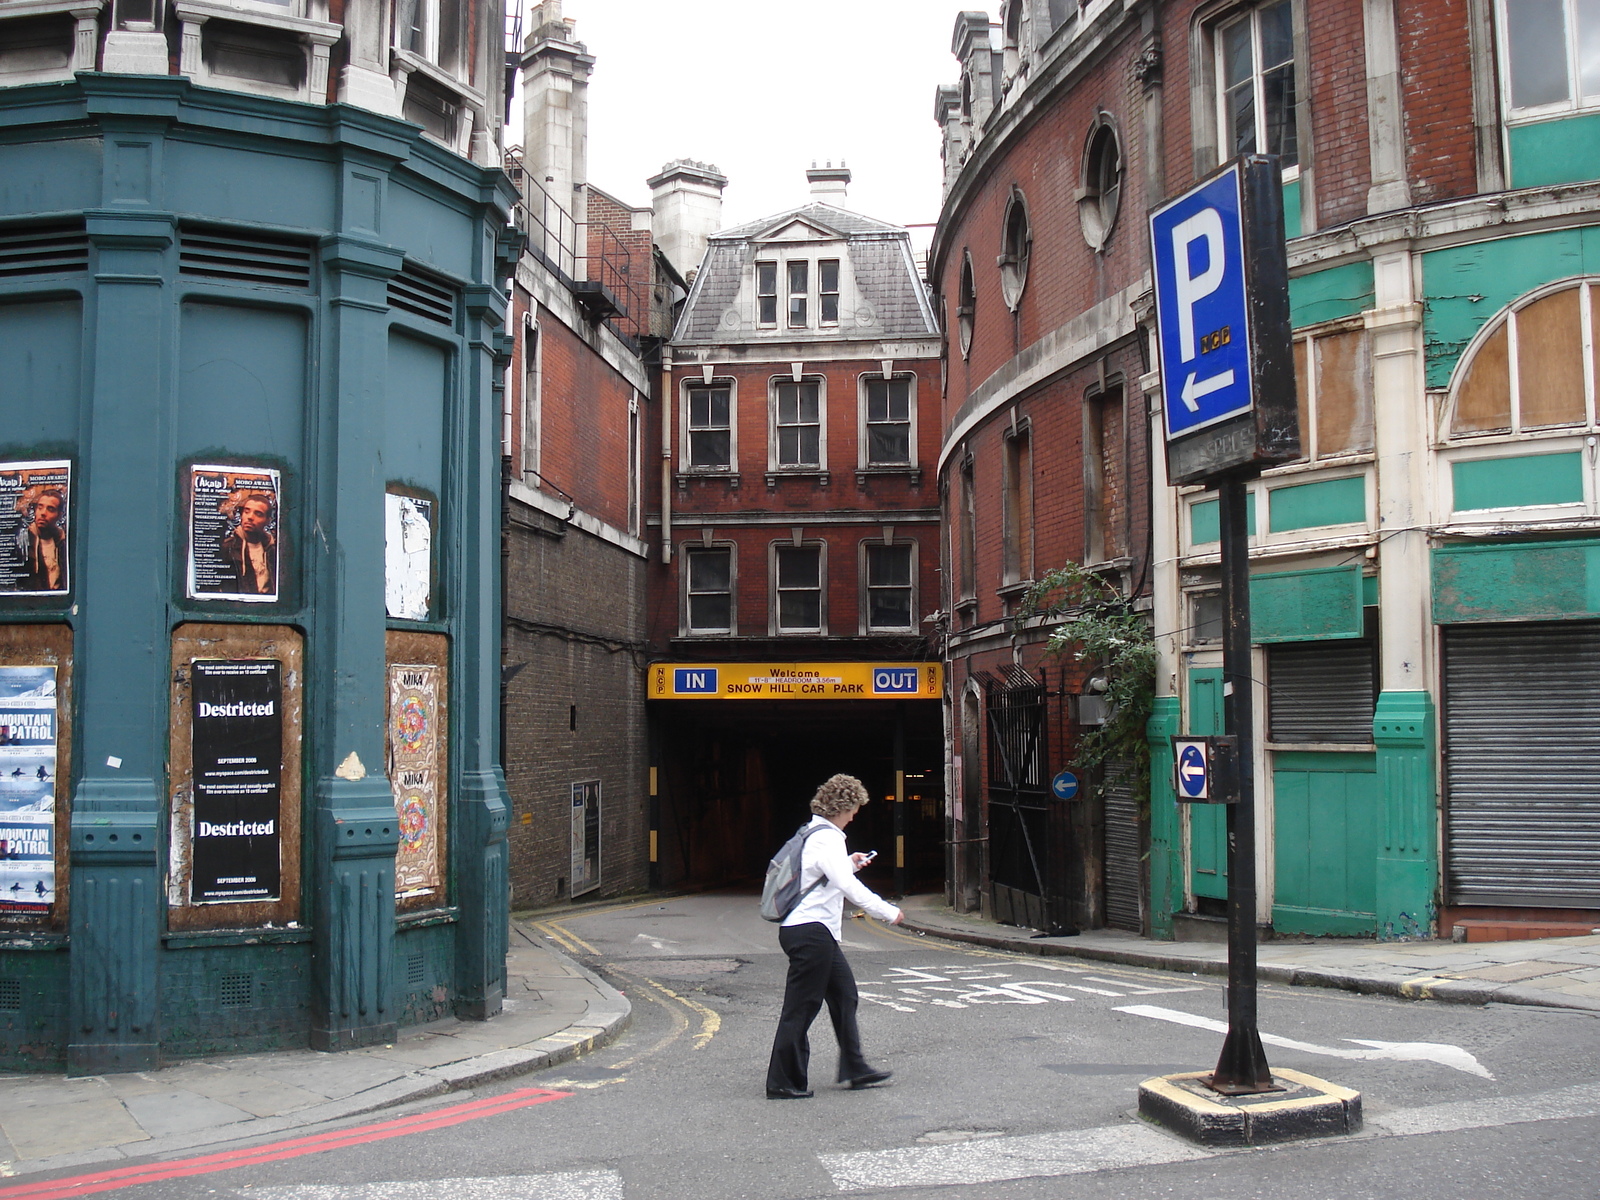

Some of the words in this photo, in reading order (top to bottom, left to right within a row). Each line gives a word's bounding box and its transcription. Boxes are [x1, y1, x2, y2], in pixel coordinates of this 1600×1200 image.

[1172, 207, 1225, 364] P
[1201, 326, 1231, 354] NCP
[404, 675, 422, 685] MIKA
[686, 673, 705, 688] IN
[876, 673, 915, 688] OUT
[728, 684, 762, 693] SNOW
[802, 685, 825, 693] CAR
[199, 701, 274, 717] Destricted
[0, 714, 51, 725] MOUNTAIN
[9, 726, 54, 739] PATROL
[404, 774, 423, 785] MIKA
[0, 829, 48, 840] MOUNTAIN
[200, 820, 274, 836] Destricted
[8, 841, 52, 854] PATROL
